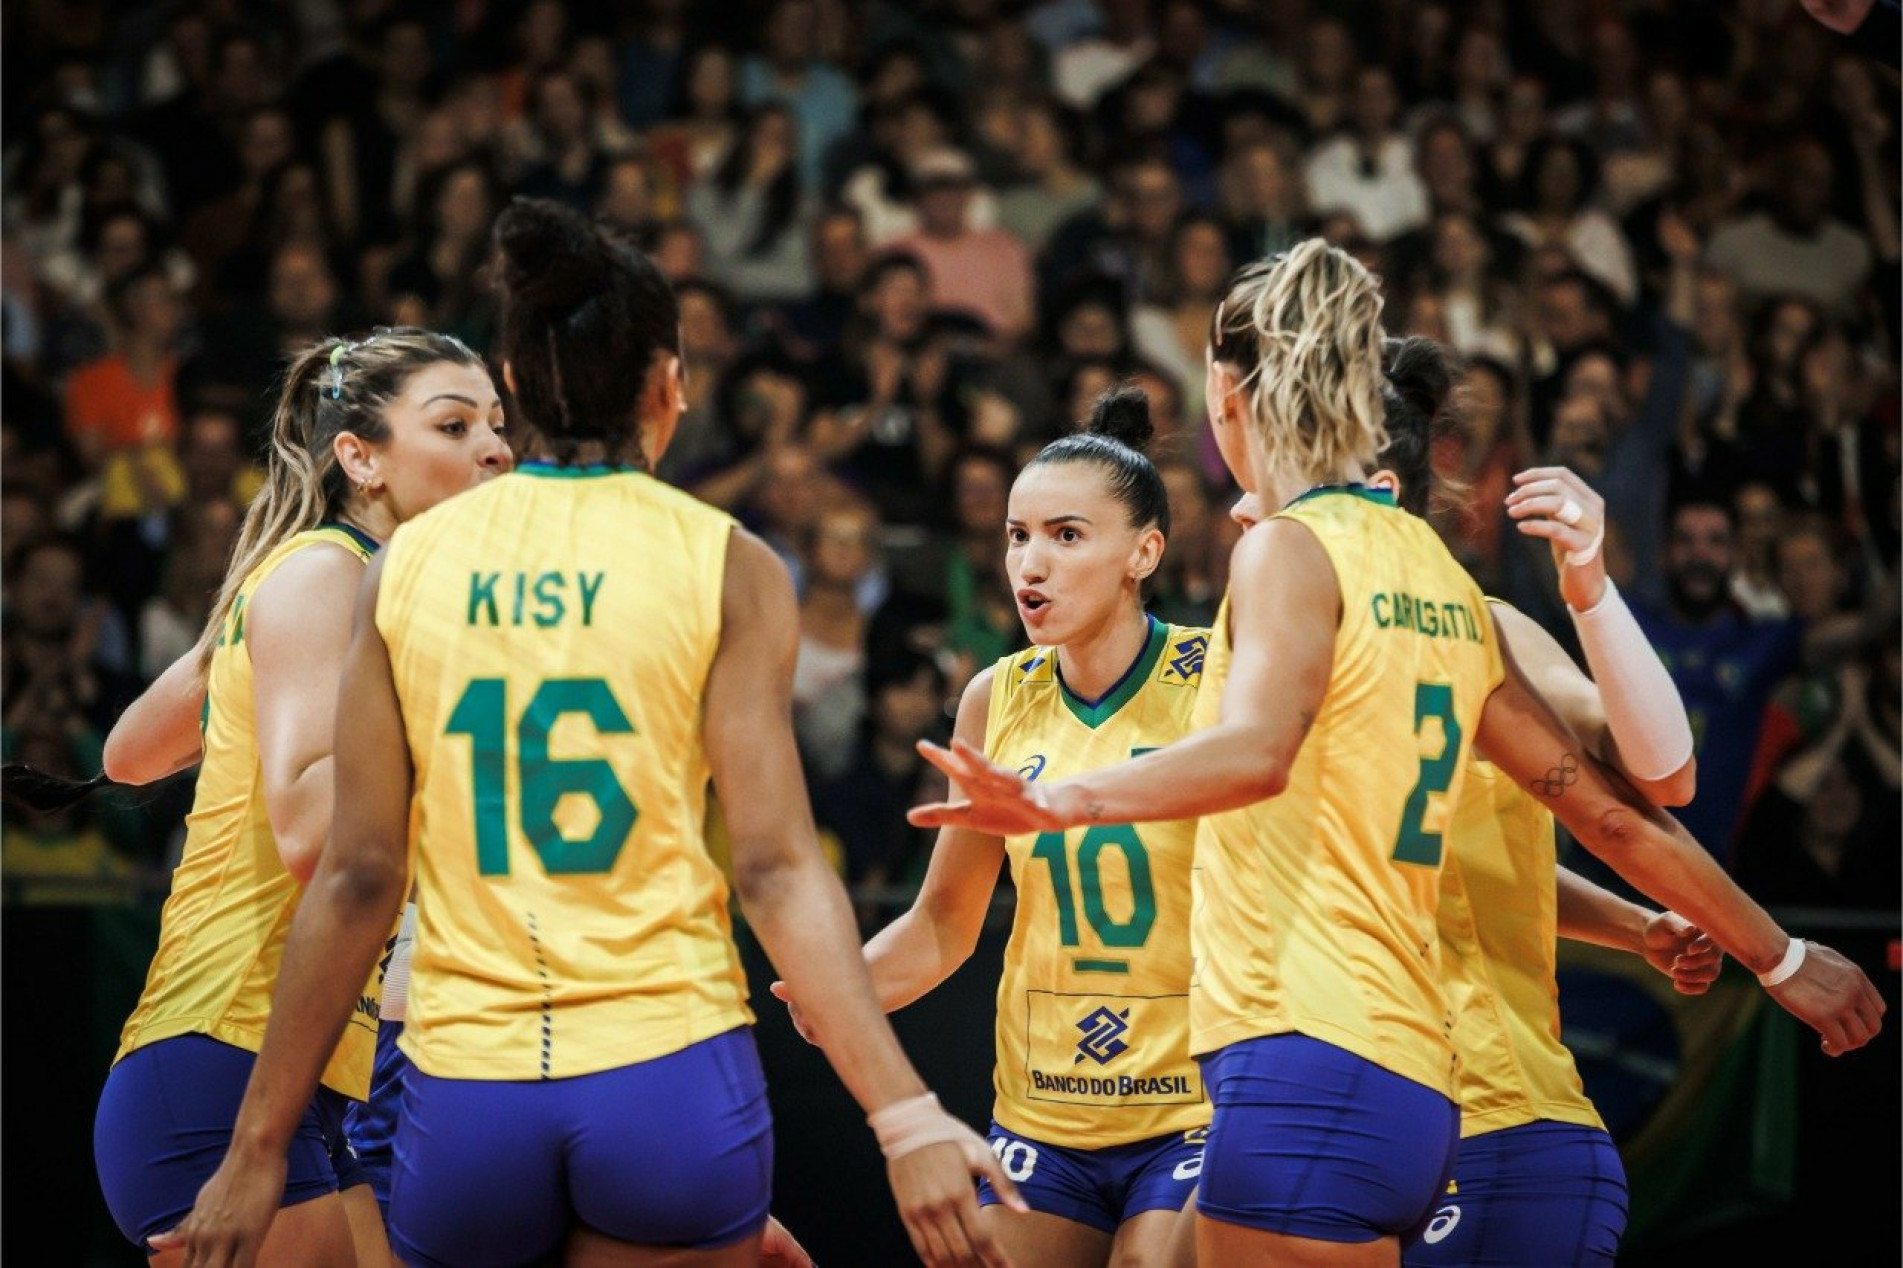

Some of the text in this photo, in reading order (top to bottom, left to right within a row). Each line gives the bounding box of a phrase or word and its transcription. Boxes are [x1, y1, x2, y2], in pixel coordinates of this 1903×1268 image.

[467, 572, 604, 628] KISY
[444, 678, 639, 876] 16
[1393, 682, 1462, 867] 2
[1031, 823, 1156, 947] 10
[1032, 1070, 1192, 1096] BANCO DO BRASIL
